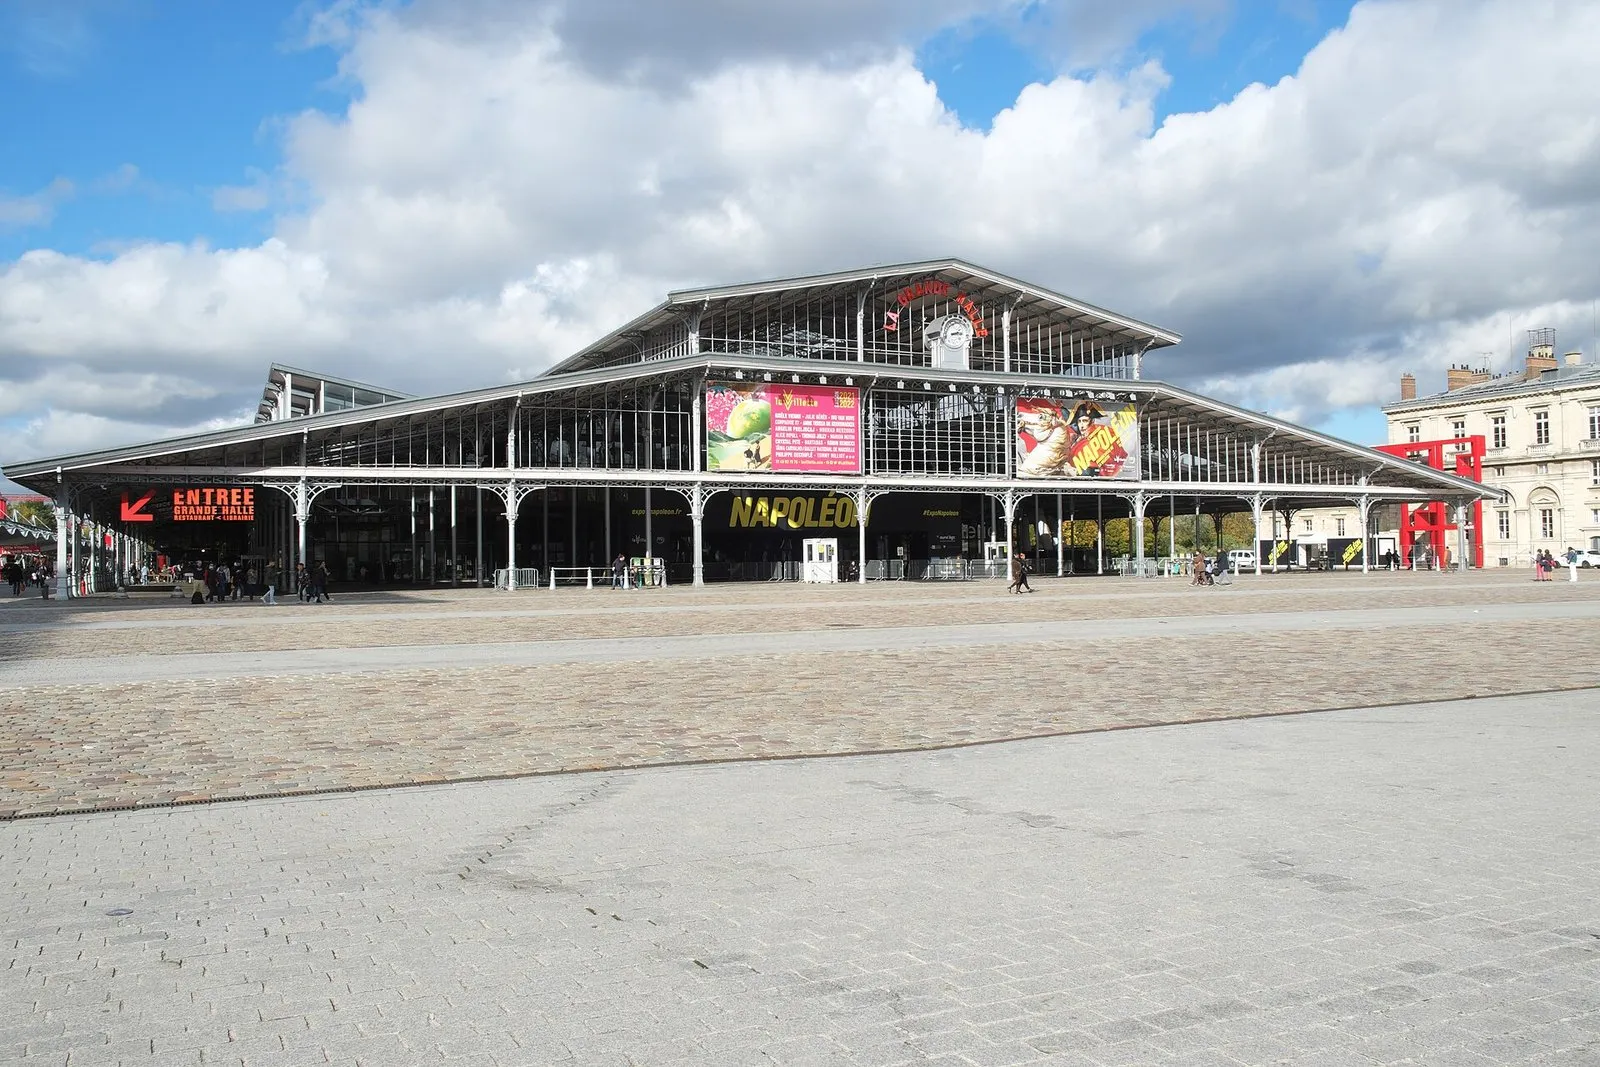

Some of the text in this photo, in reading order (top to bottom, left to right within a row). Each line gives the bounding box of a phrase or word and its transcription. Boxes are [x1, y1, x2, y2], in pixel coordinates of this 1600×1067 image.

[883, 279, 988, 338] LA GRANDE HALLE
[840, 399, 855, 408] 2022
[174, 488, 254, 505] ENTREE
[174, 506, 254, 515] GRANDE HALLE
